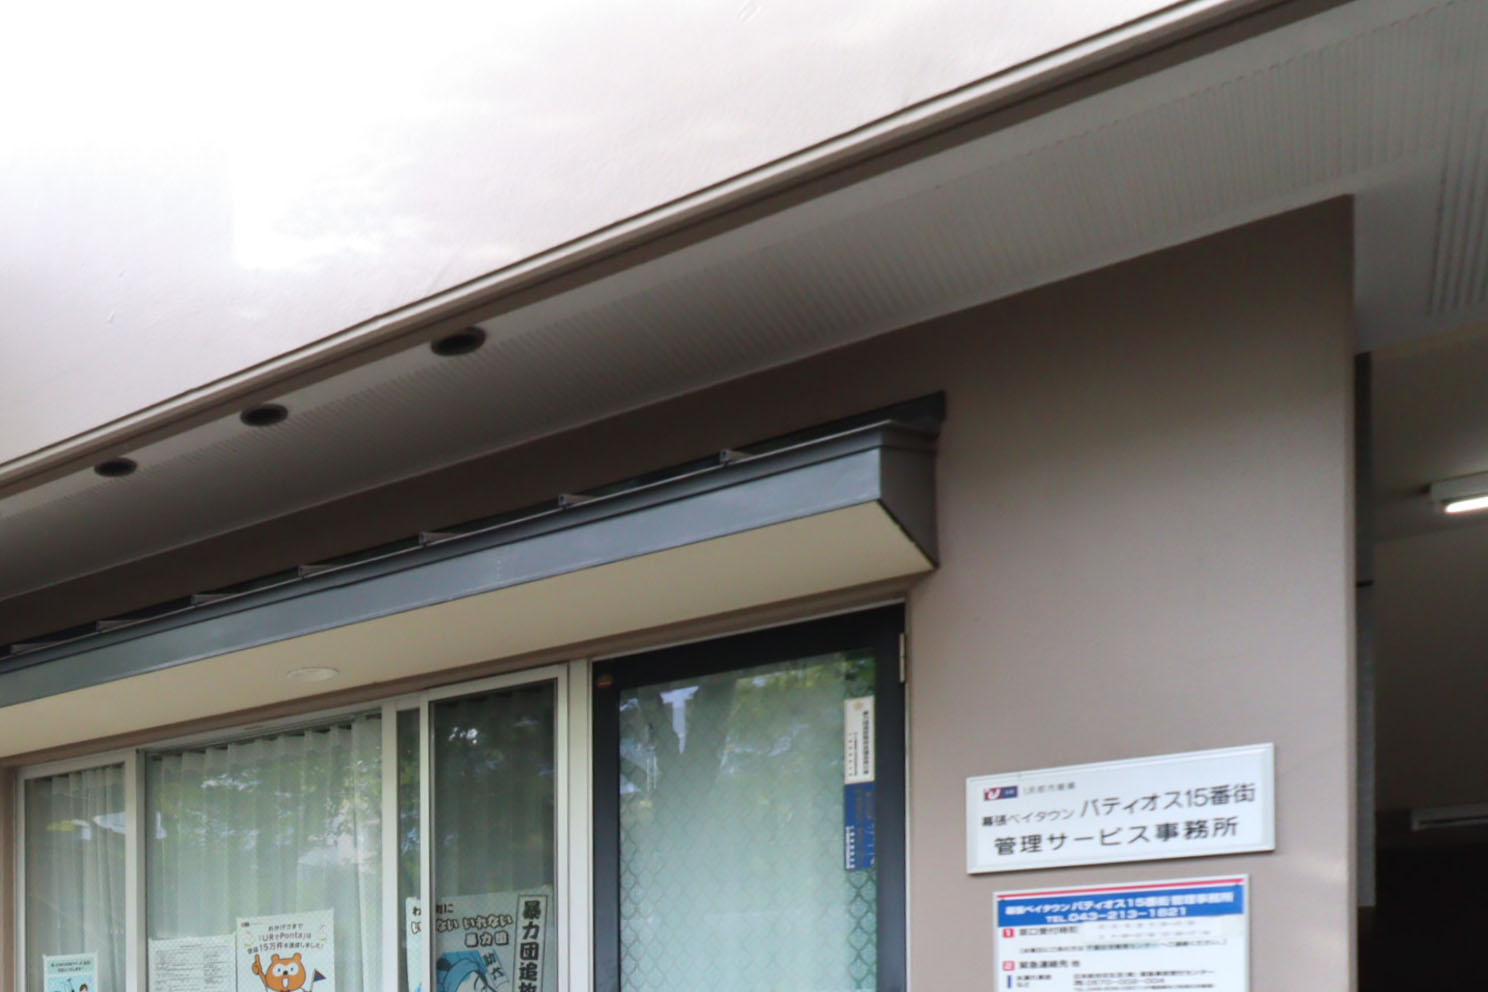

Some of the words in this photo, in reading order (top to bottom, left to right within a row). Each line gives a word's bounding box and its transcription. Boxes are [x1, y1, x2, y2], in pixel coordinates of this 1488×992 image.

[1079, 782, 1255, 818] パティオス15番街
[994, 816, 1239, 856] 管理サービス事務所
